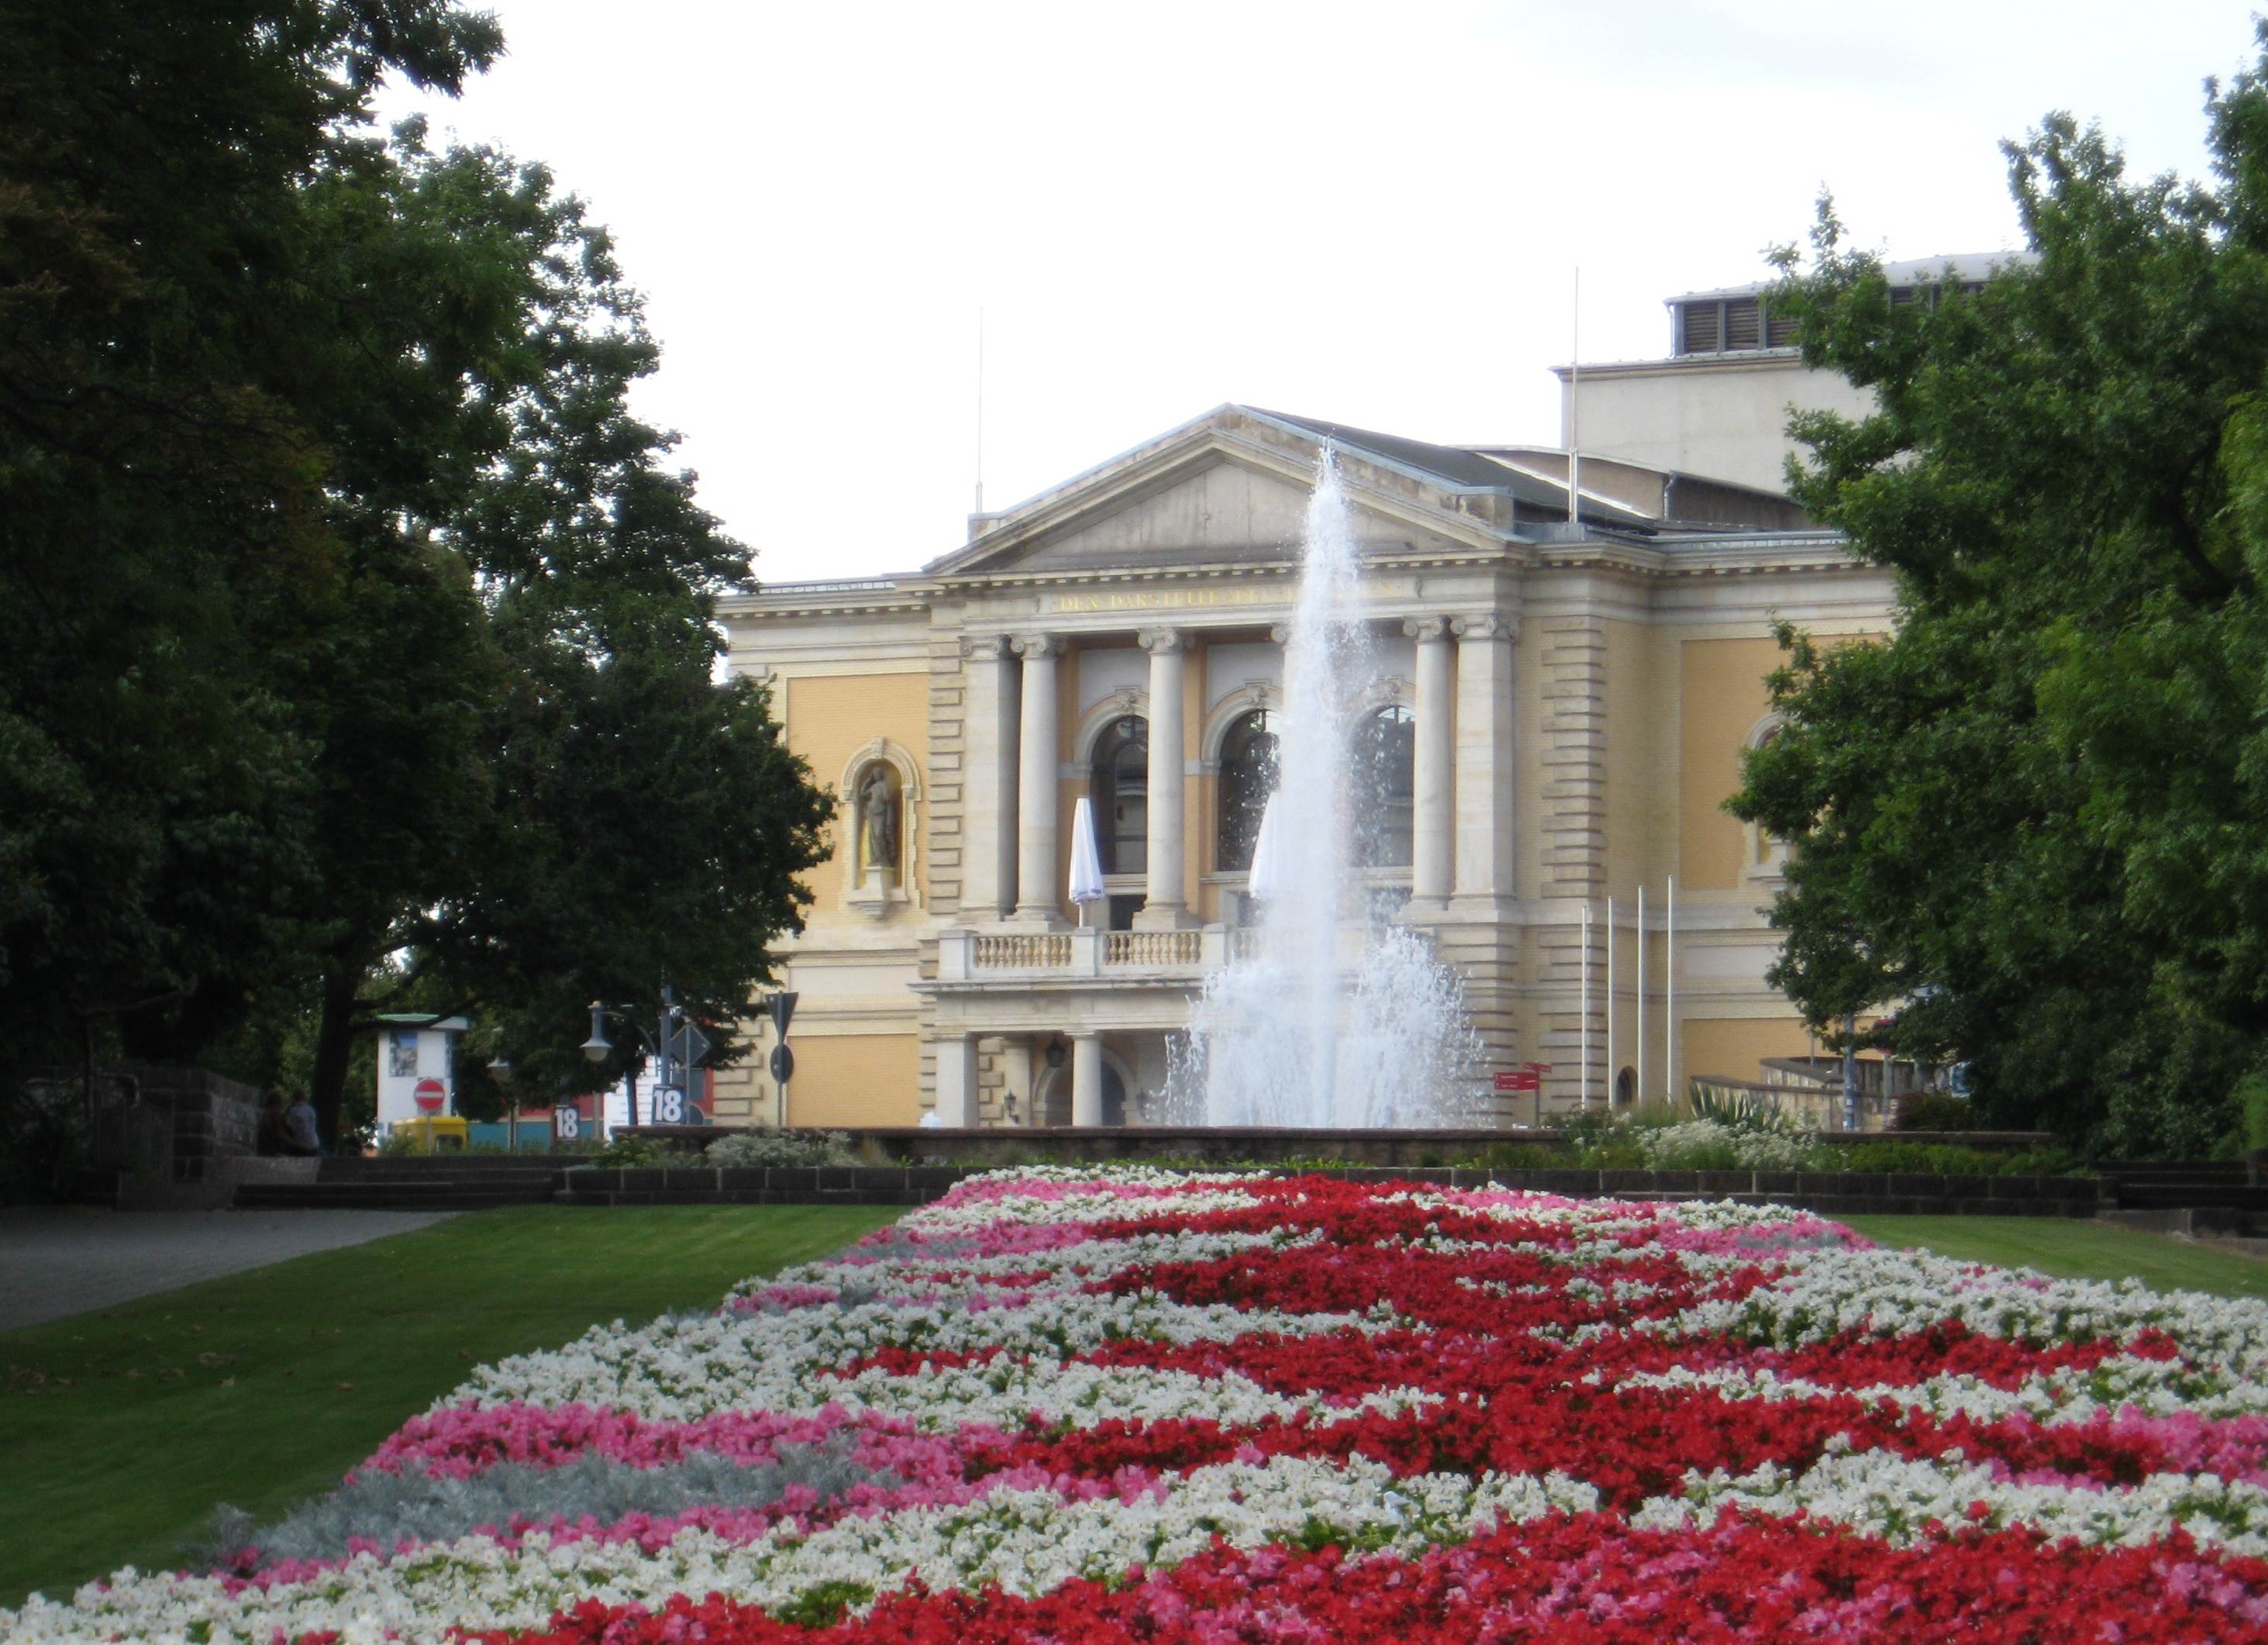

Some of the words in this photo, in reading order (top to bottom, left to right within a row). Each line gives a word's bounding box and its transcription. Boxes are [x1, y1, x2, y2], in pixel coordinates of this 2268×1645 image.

[1060, 593, 1098, 610] DEN
[653, 1089, 682, 1123] 18
[555, 1107, 578, 1139] 18
